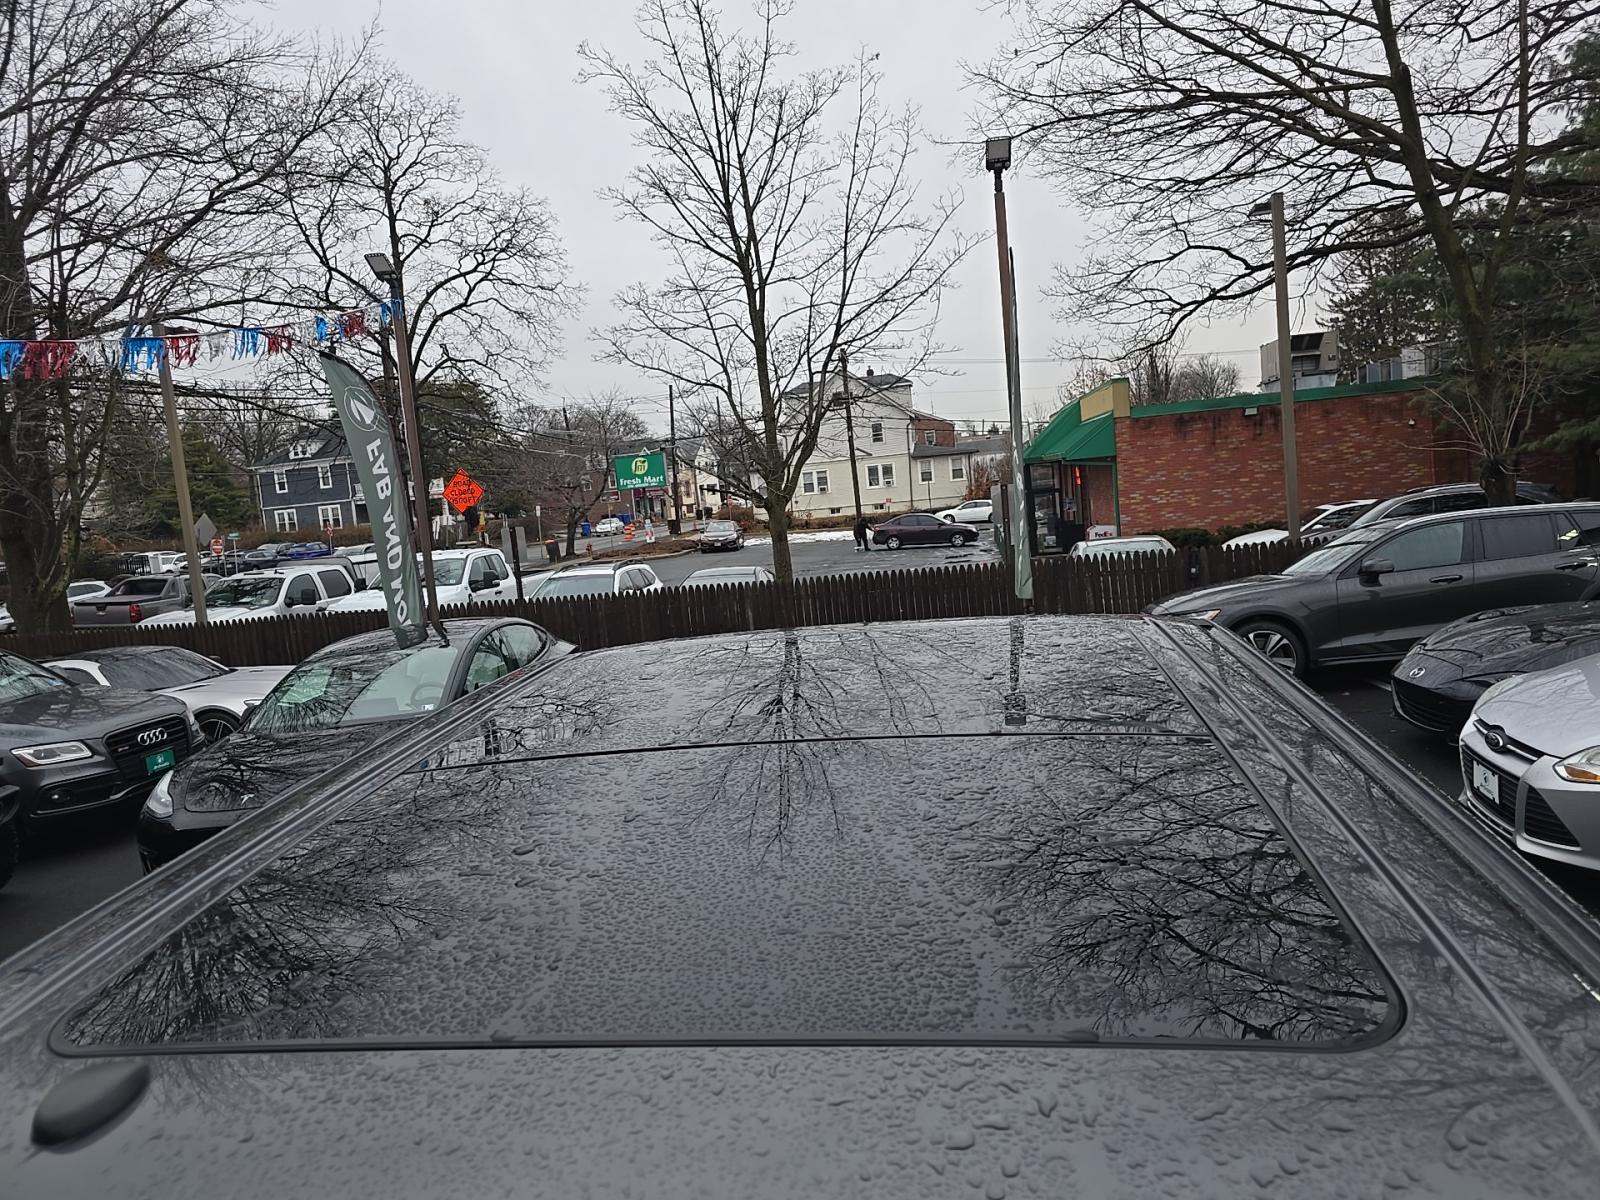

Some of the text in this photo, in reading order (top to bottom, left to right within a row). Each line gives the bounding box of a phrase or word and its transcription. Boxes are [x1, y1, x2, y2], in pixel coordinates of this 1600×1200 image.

[620, 477, 641, 486] Fresh
[644, 475, 664, 483] Mart
[450, 487, 475, 497] CLOSED
